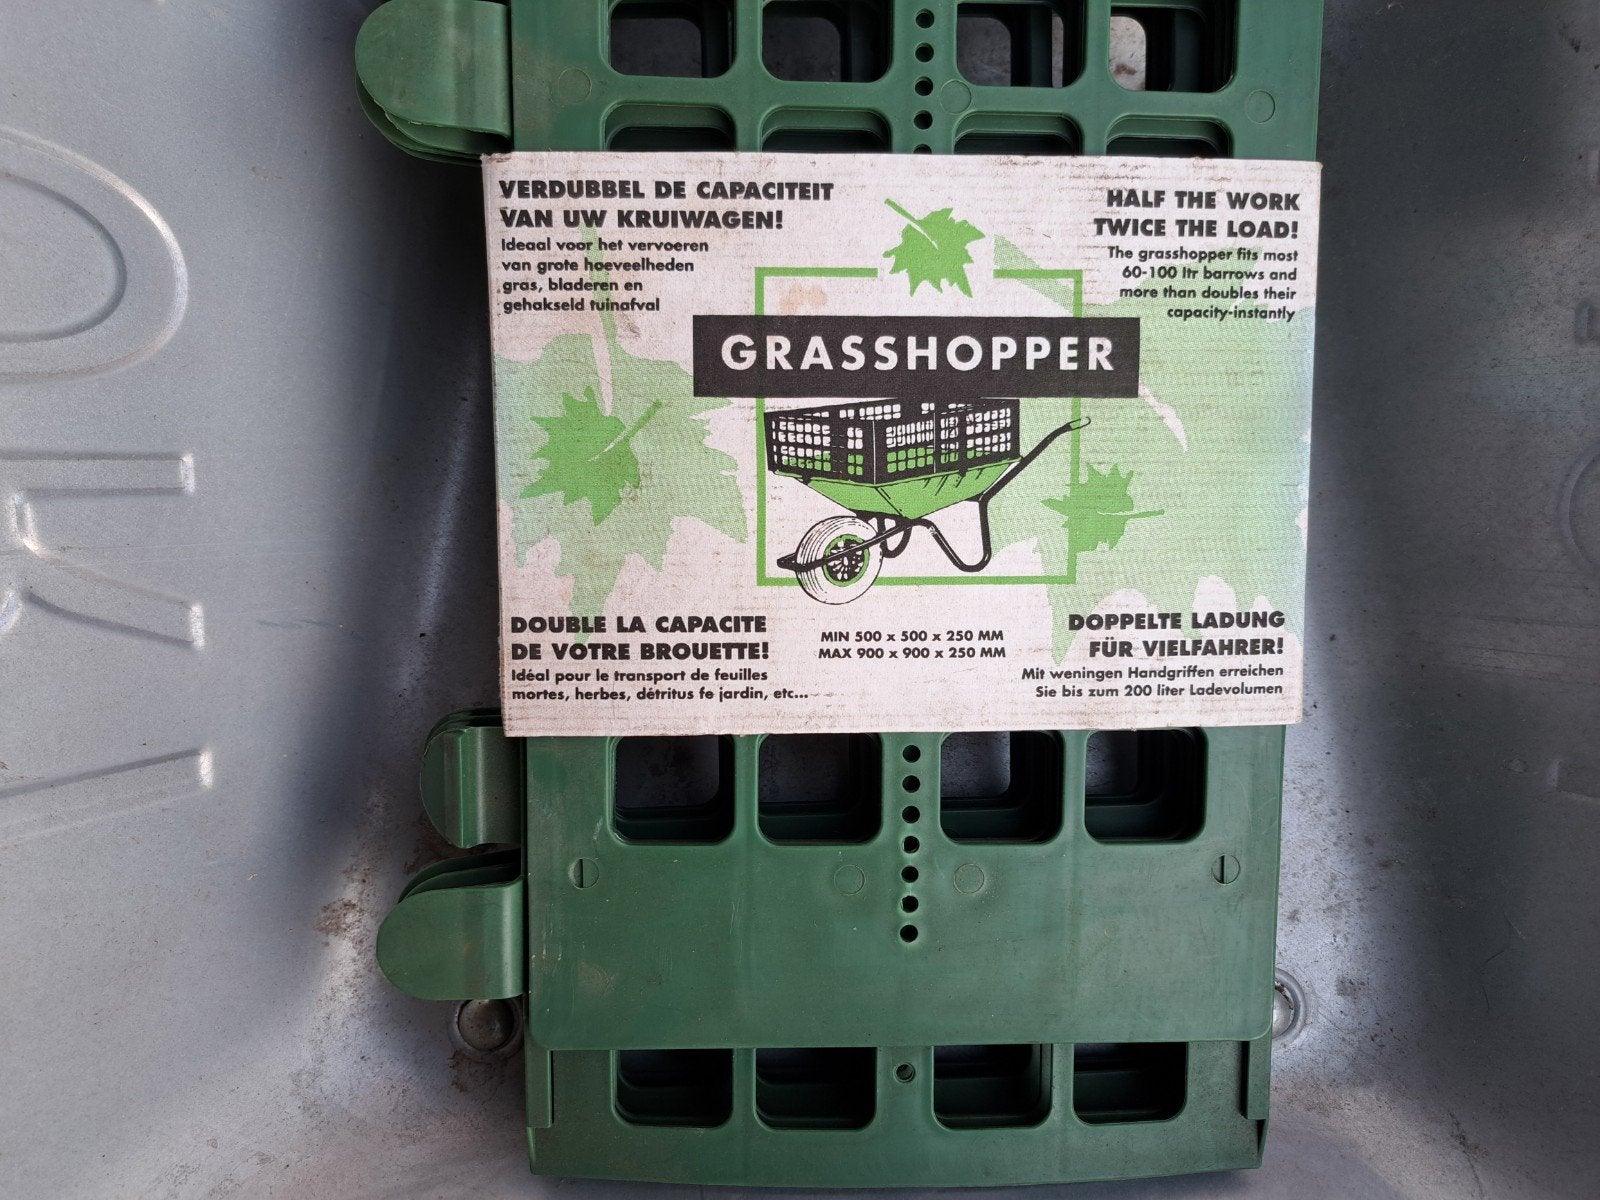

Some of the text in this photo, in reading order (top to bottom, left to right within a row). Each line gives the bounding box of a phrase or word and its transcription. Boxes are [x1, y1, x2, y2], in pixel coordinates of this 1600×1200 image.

[499, 180, 834, 201] VERDUBBEL DE CAPACITEIT
[1107, 189, 1300, 210] HALF THE WORK
[500, 209, 784, 229] VAN UW KRUIWAGEN!
[1093, 218, 1299, 239] TWICE THE LOAD!
[501, 238, 709, 252] Ideaal voor het vervoeren
[1107, 246, 1298, 262] The grasshopper fits most
[501, 258, 695, 274] van grote hoeveelheden
[1122, 266, 1177, 279] 60-100
[1203, 268, 1265, 281] barrows
[1269, 269, 1297, 281] and
[502, 278, 643, 293] gras, bladeren en
[1119, 286, 1297, 300] more than doubles their
[503, 298, 660, 314] gehakseld tuinafval
[1167, 305, 1295, 323] capacity-instantly
[721, 333, 1115, 372] GRASSHOPPER
[511, 615, 767, 634] DOUBLE LA CAPACITE
[1068, 610, 1285, 631] DOPPELTE LADUNG
[820, 630, 1004, 642] MIN 500 x 500 x 250 MM
[511, 642, 769, 660] DE VOTRE BROUETTE!
[818, 647, 1006, 659] MAX 900 x 900 x 250 MM
[1089, 636, 1284, 658] FÜR VIELFAHRER!
[512, 668, 768, 685] Idéal pour le transport de feuilles
[1021, 664, 1284, 682] Mit weningen Handgriffen erreichen
[512, 689, 570, 702] mortes,
[575, 688, 630, 702] herbes,
[636, 687, 694, 700] détritus
[718, 687, 768, 702] jardin,
[773, 688, 809, 699] etc...
[1035, 683, 1283, 698] Sie bis zum 200 liter Ladevolumen
